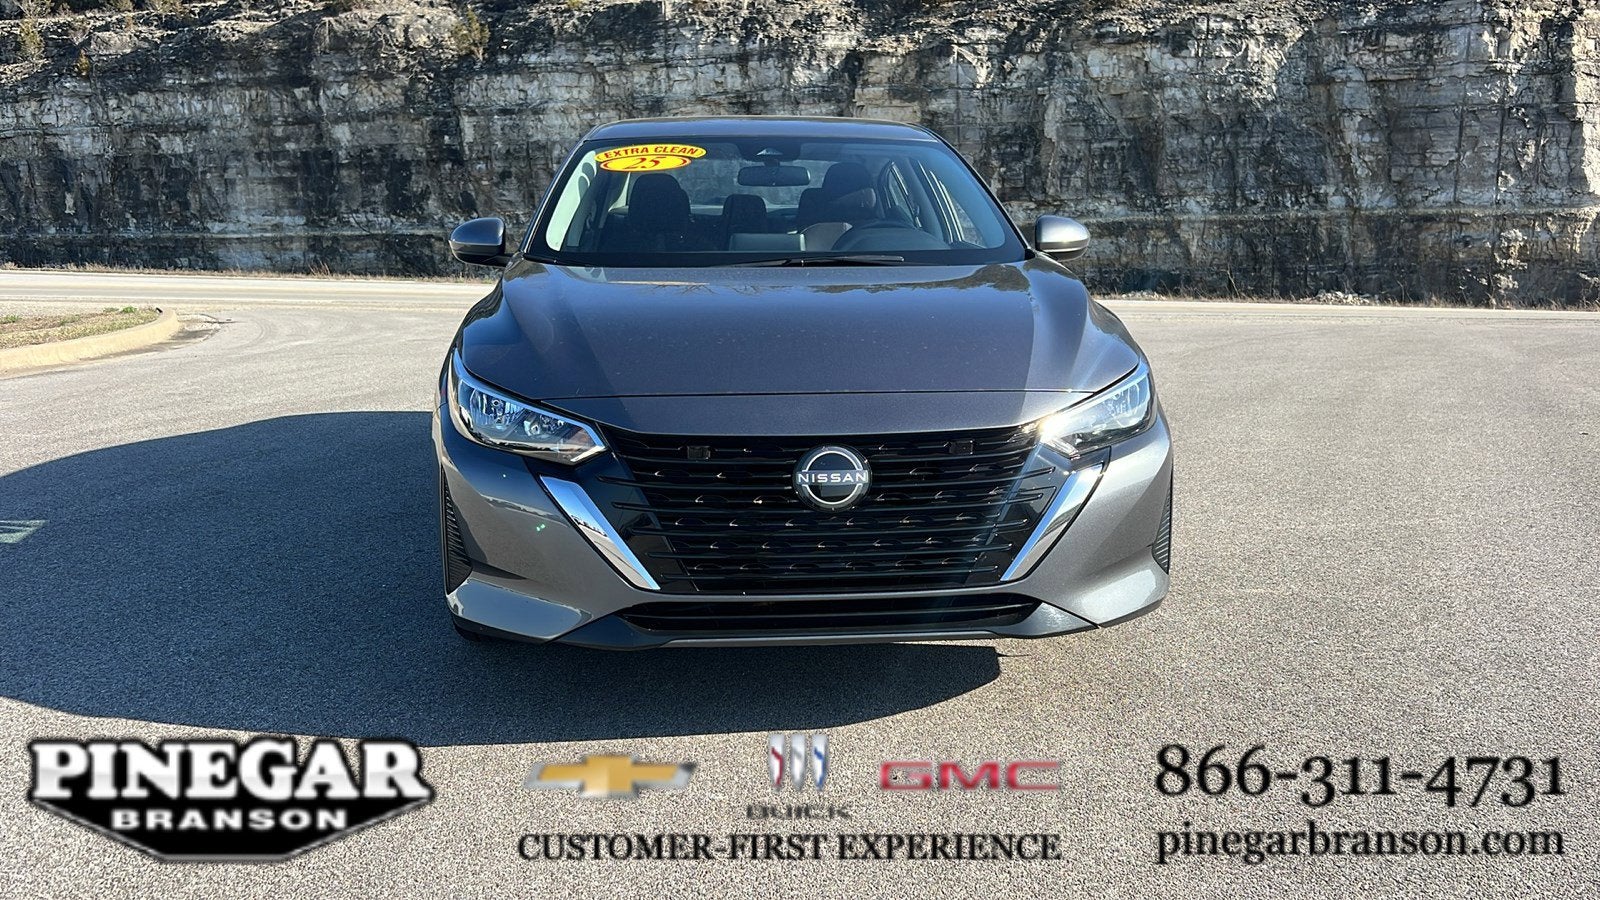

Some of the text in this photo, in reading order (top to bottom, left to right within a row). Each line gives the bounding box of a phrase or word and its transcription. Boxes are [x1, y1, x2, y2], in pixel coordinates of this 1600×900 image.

[604, 146, 698, 158] EXTRA CLEAN
[623, 156, 666, 169] 25
[798, 472, 867, 483] NISSAN
